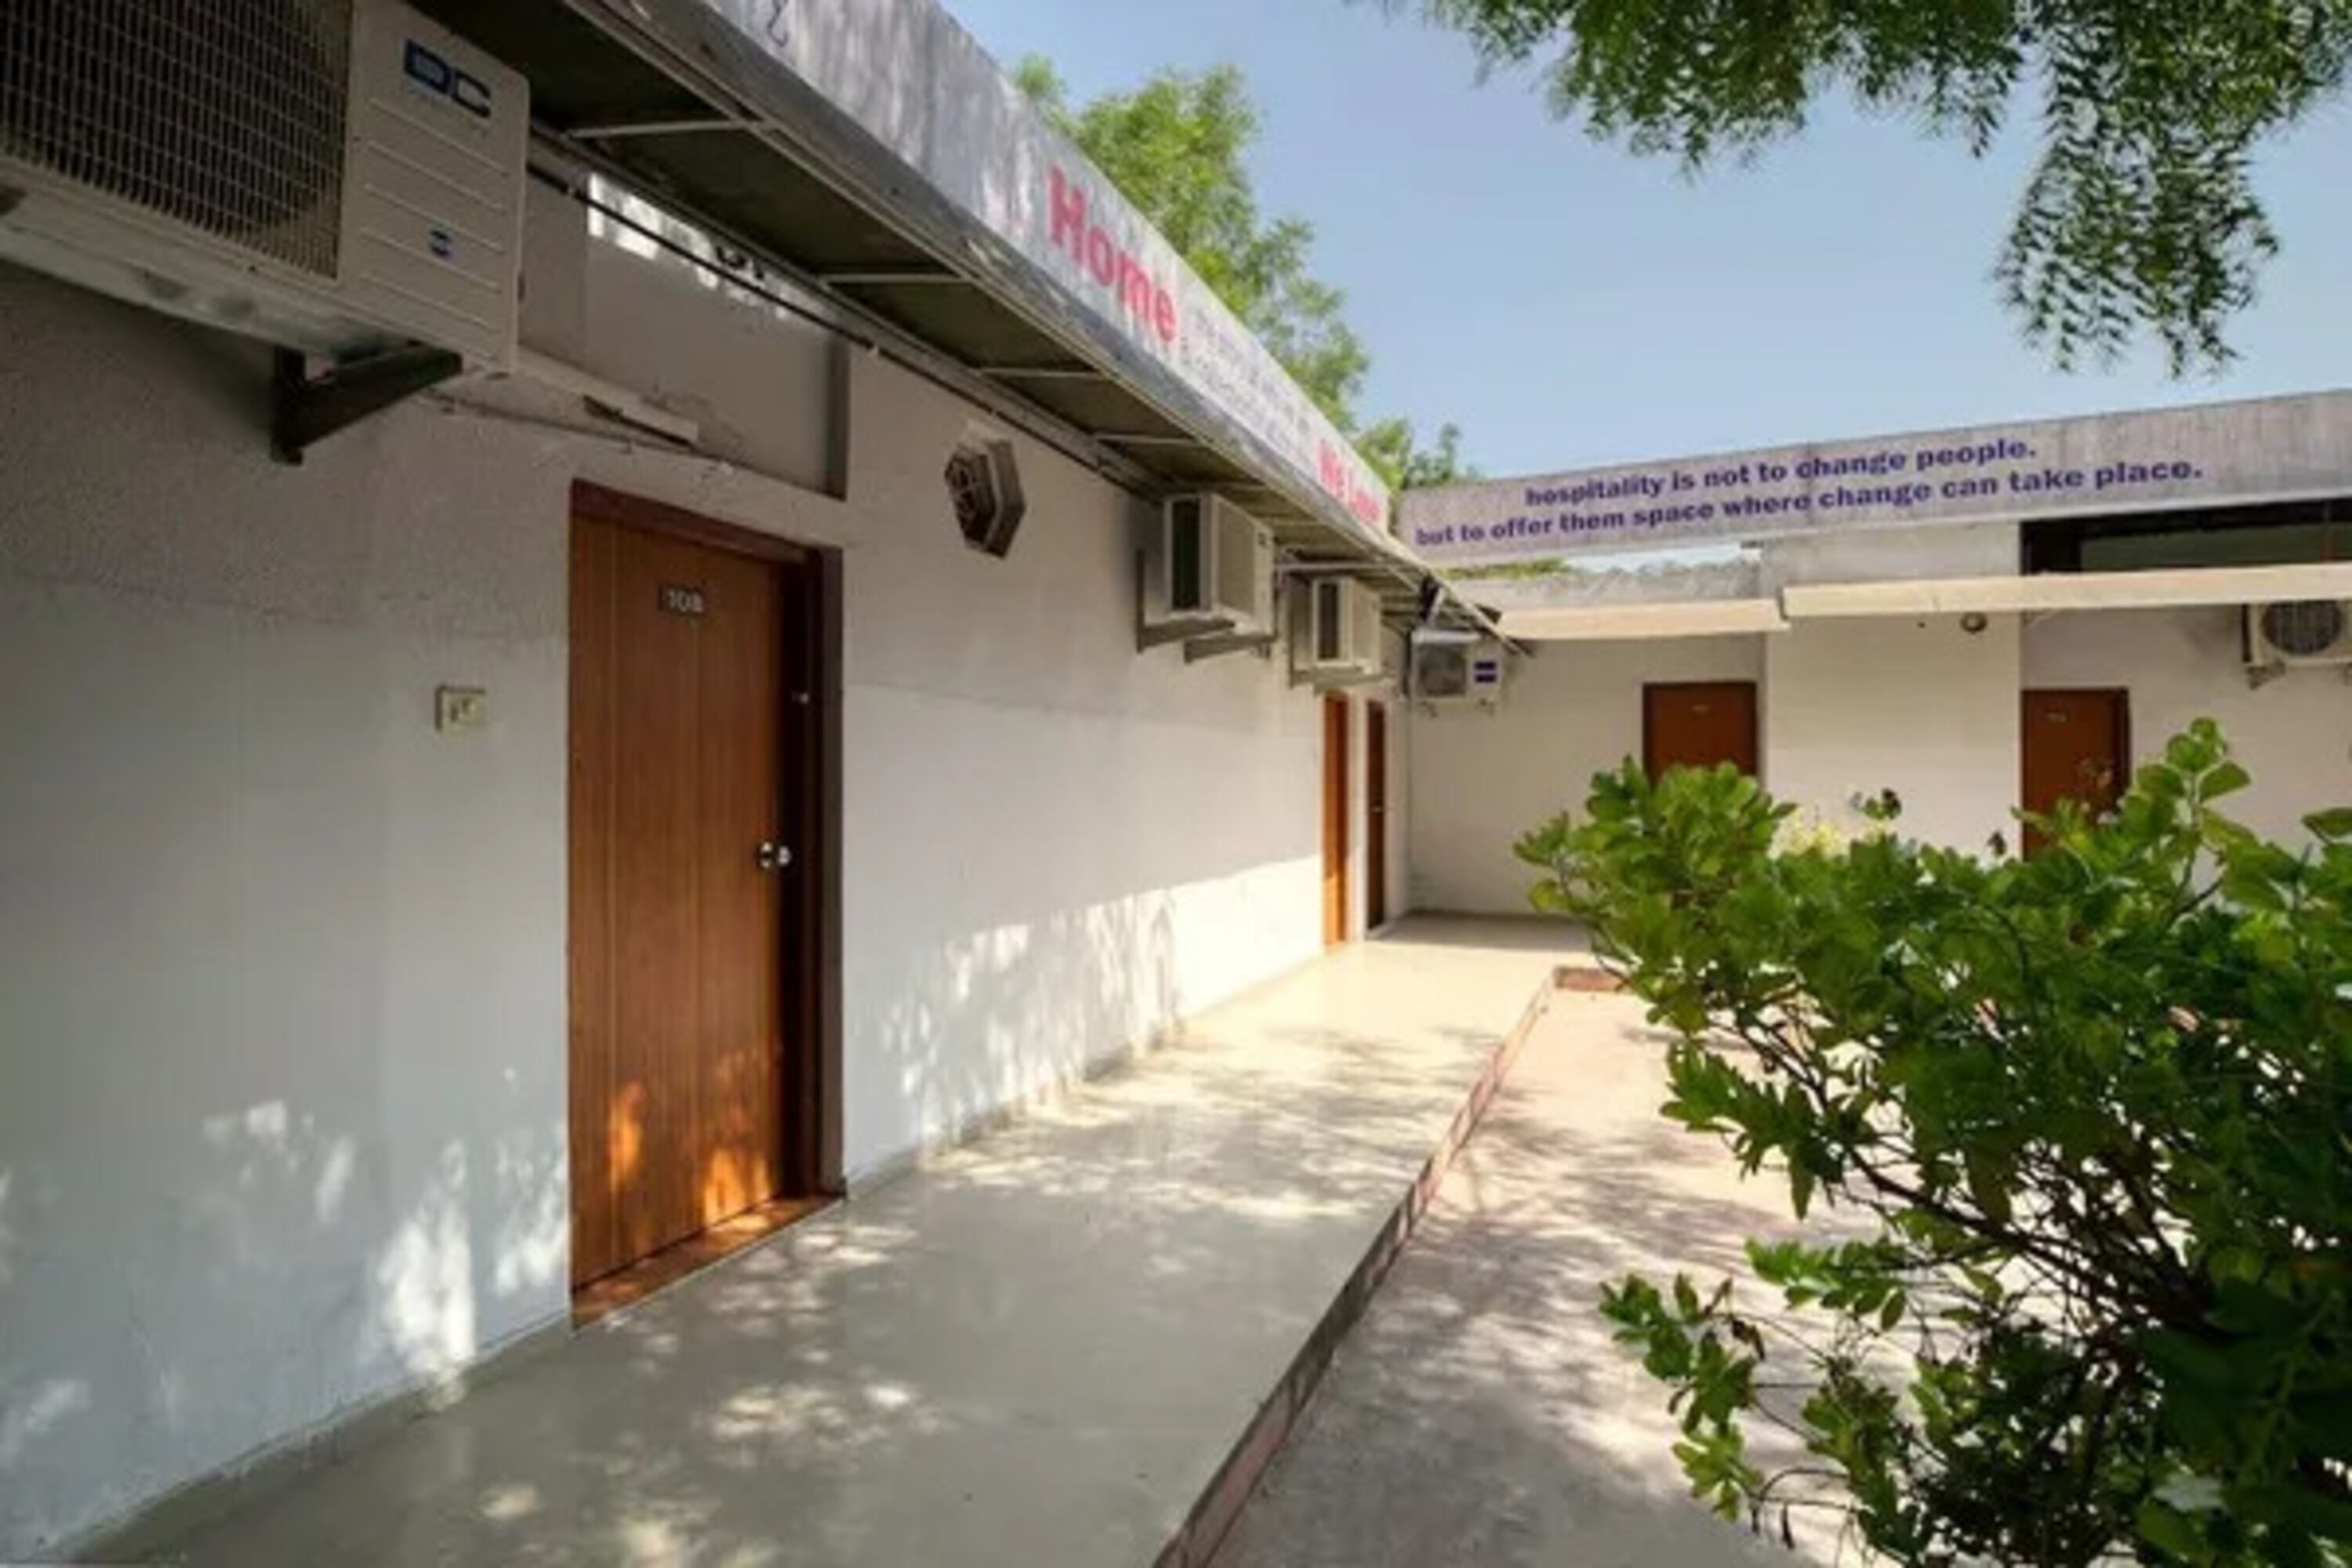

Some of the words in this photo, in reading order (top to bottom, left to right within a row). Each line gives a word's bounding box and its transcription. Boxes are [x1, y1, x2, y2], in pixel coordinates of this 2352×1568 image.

[1047, 161, 1176, 343] Home
[1415, 524, 1454, 546] but
[1461, 523, 1486, 543] to
[1490, 516, 1554, 539] offer
[1559, 510, 1625, 532] them
[1632, 503, 1715, 528] space
[1721, 494, 1812, 518] where
[1818, 482, 1932, 507] change
[1940, 474, 1999, 499] can
[2009, 467, 2085, 494] take
[2095, 459, 2204, 491] place.
[1524, 474, 1665, 507] hospitality
[1671, 470, 1696, 492] is
[1704, 464, 1750, 488] not
[1759, 461, 1788, 483] to
[1795, 451, 1906, 480] change
[1915, 438, 2037, 470] people.
